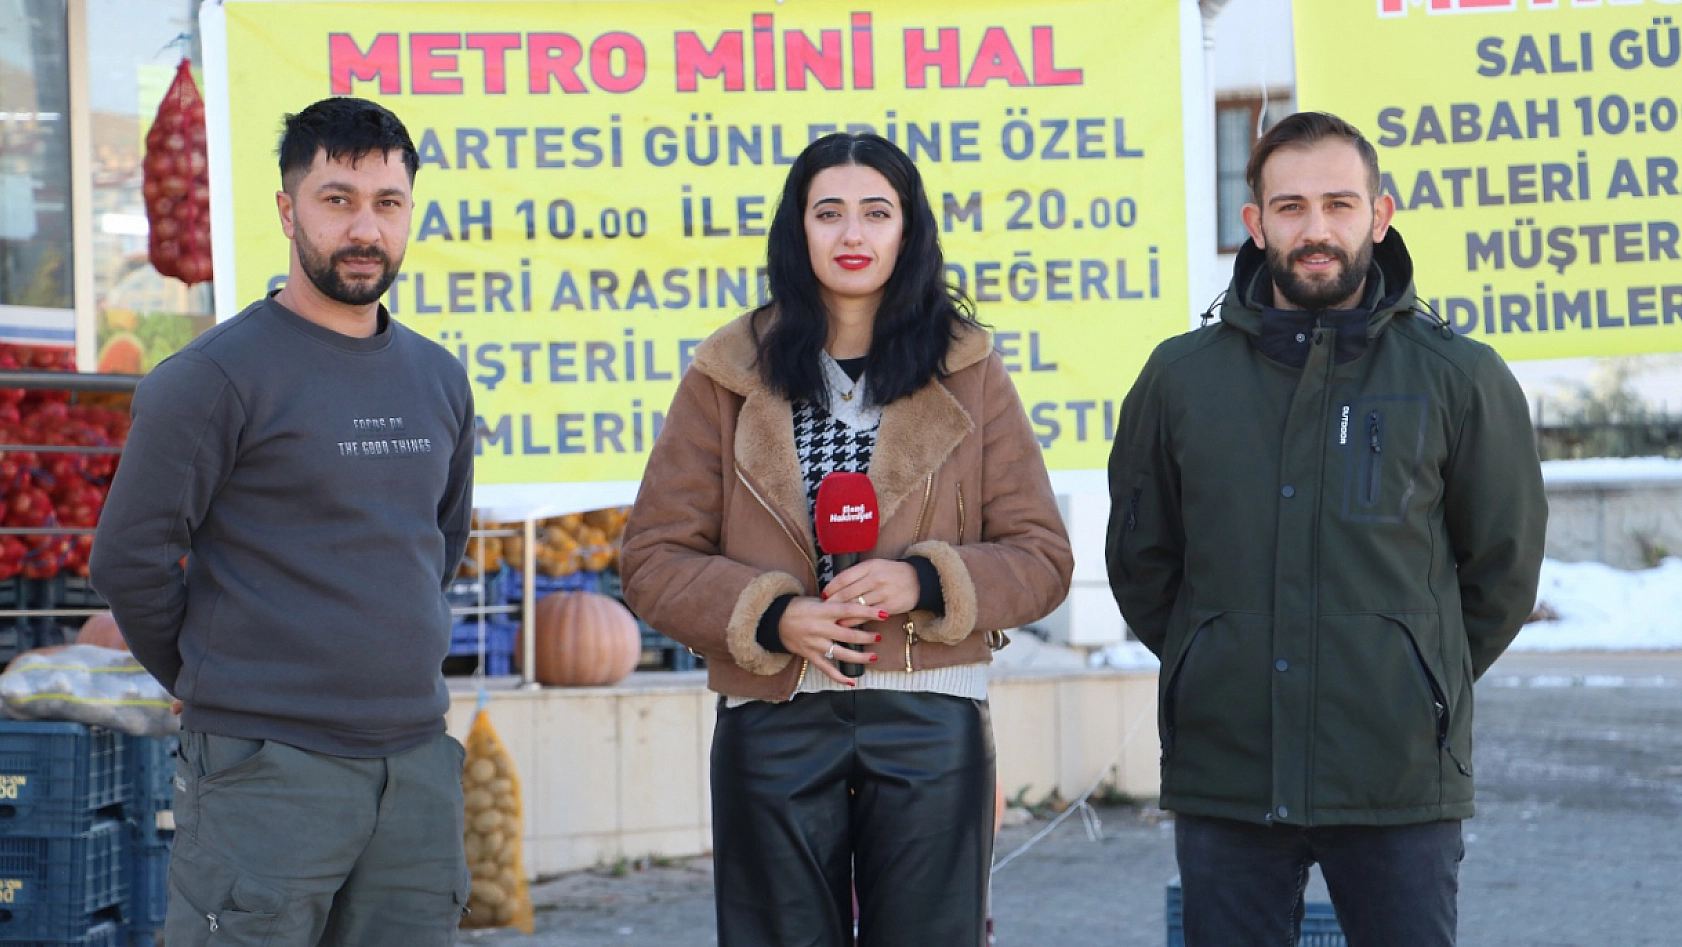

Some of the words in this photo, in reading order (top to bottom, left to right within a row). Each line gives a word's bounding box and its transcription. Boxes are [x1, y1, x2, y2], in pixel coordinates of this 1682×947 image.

[328, 31, 646, 95] METRO
[675, 12, 875, 92] MİNİ
[903, 26, 1083, 89] HAL
[1476, 32, 1594, 77] SALI
[1609, 17, 1681, 69] GÜ
[418, 114, 623, 170] ARTESİ
[1001, 108, 1145, 160] ÖZEL
[1377, 98, 1560, 147] SABAH
[1574, 94, 1682, 138] 10:0
[1379, 151, 1591, 211] AATLERİ
[1606, 157, 1682, 199] AR
[416, 199, 492, 241] AH
[515, 199, 647, 241] 10.00
[682, 185, 767, 237] İLE
[1006, 189, 1137, 230] 20.00
[1466, 217, 1681, 276] MÜŞTER
[1428, 282, 1682, 335] DİRİMLER
[993, 331, 1058, 372] EL
[337, 442, 359, 456] THE
[362, 441, 389, 455] GOOD
[391, 439, 431, 453] THINGS
[353, 418, 386, 429] FOCUS
[1340, 405, 1350, 445] OUTDOOR
